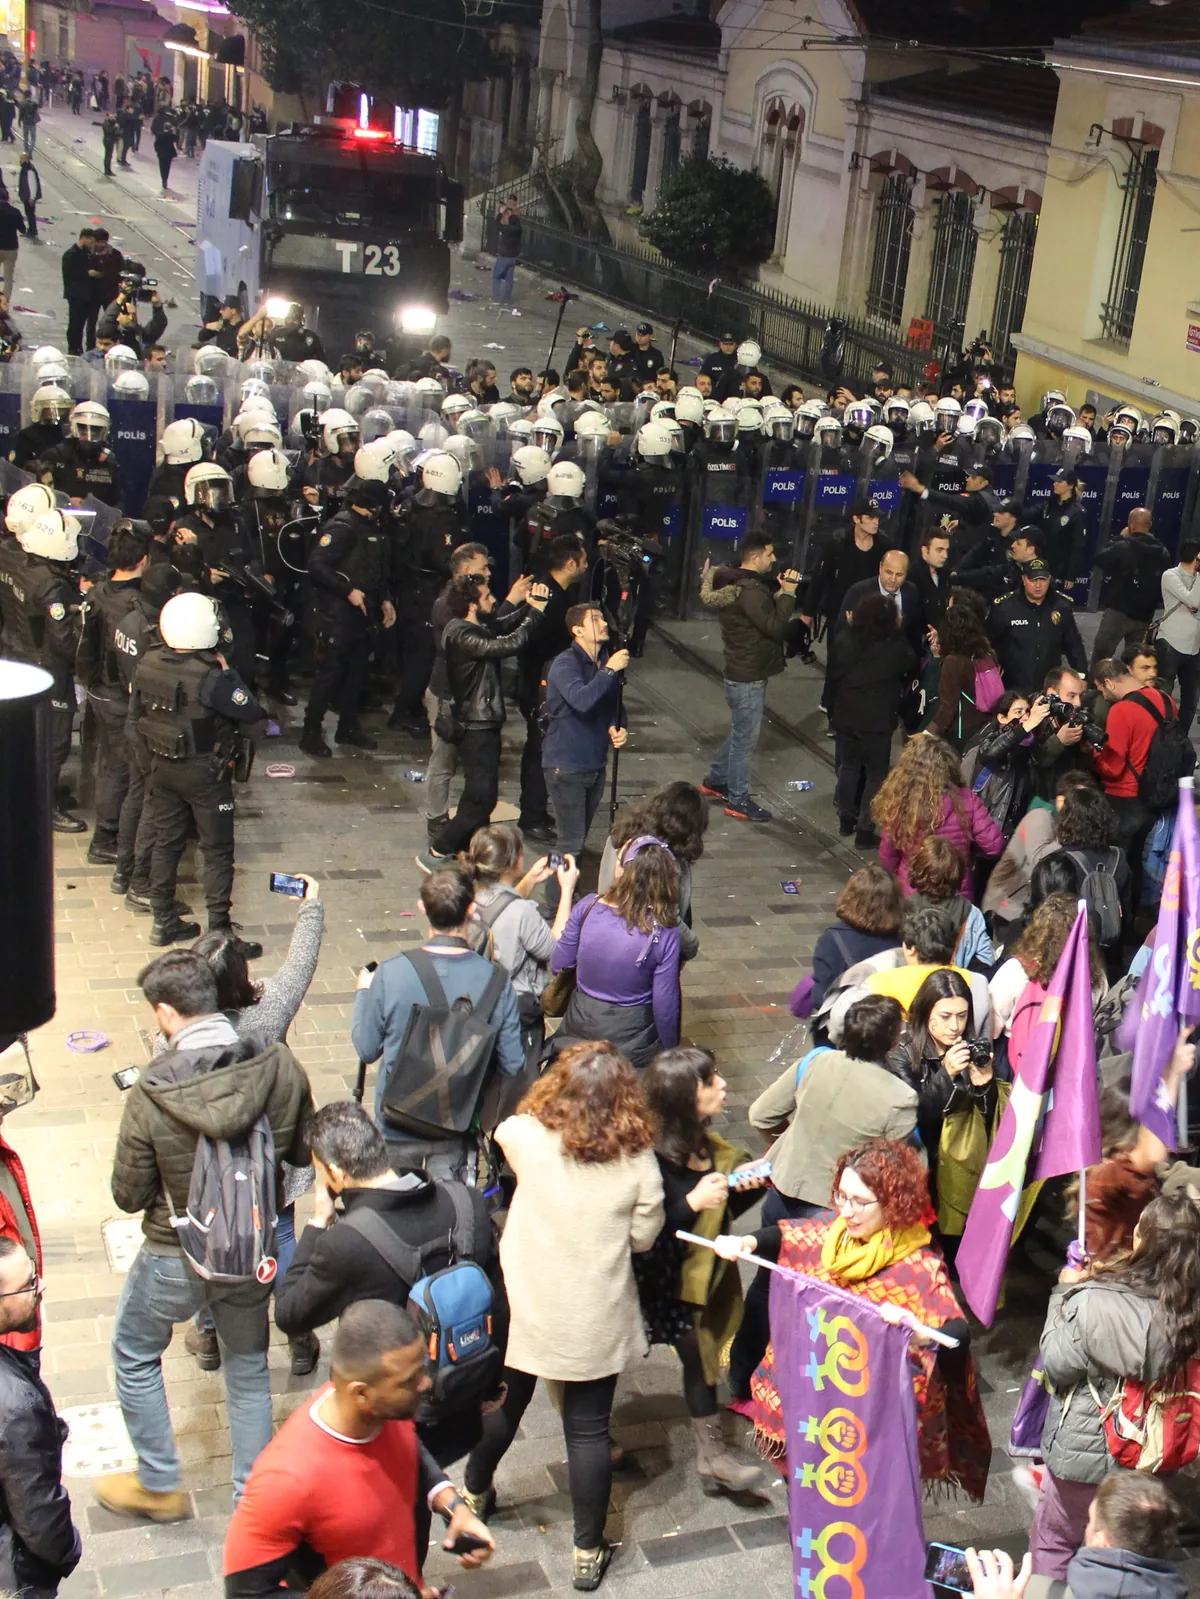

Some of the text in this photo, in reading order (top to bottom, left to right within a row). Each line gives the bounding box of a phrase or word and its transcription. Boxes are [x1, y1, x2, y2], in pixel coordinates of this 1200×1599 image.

[336, 242, 400, 276] T 23
[117, 429, 147, 441] POLİS
[772, 482, 795, 491] POLİS
[823, 485, 847, 495] POLİS
[938, 482, 960, 491] POLİS
[873, 491, 893, 500] POLİS
[1032, 488, 1051, 497] POLİS
[1081, 490, 1098, 499] OLİS
[1121, 491, 1140, 499] POLİS
[1162, 491, 1180, 499] POLİS
[477, 505, 493, 514] POL
[711, 517, 737, 528] POLİS
[114, 628, 137, 657] POLİS
